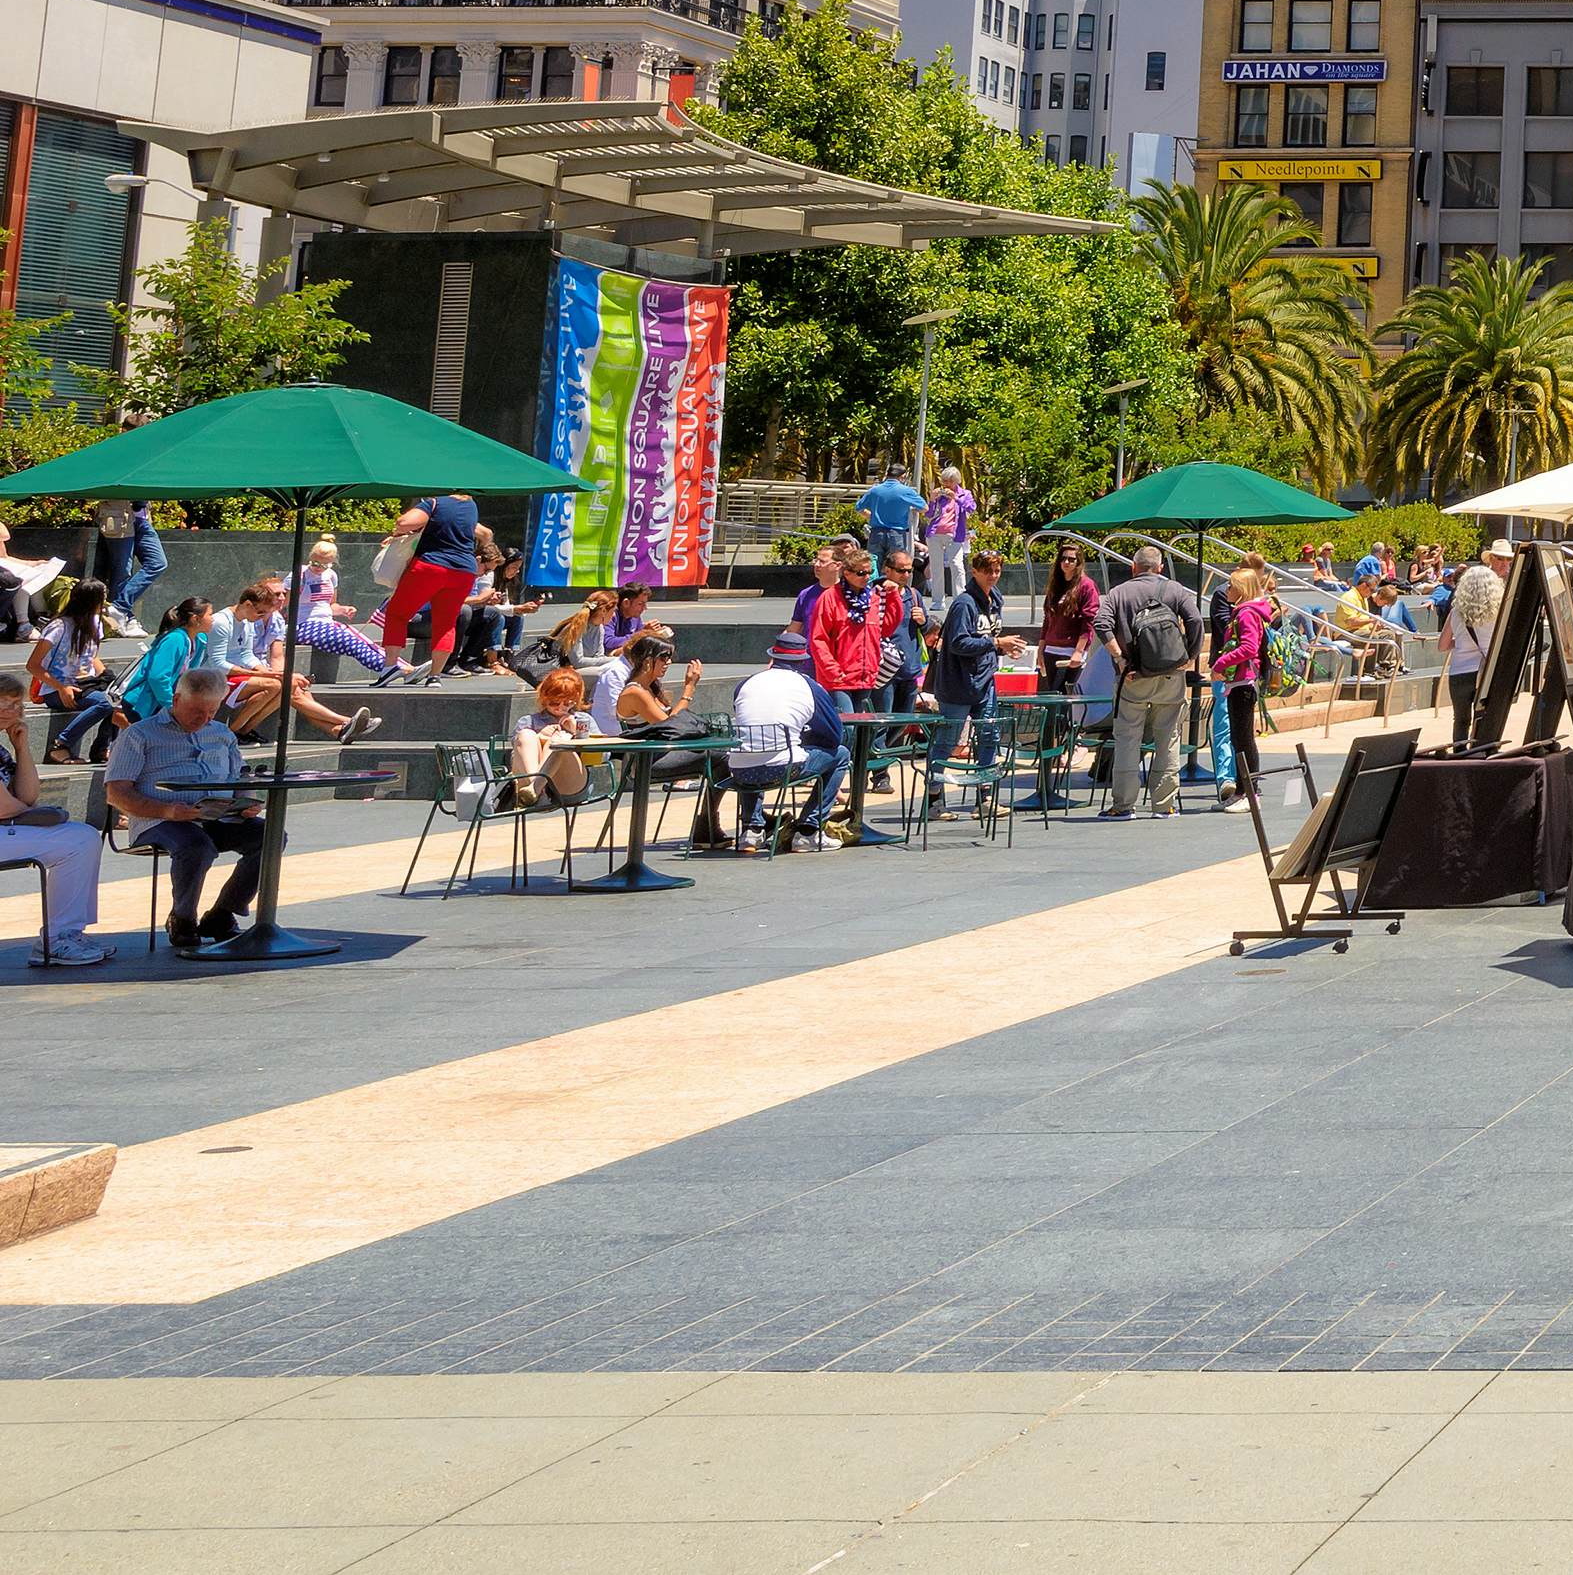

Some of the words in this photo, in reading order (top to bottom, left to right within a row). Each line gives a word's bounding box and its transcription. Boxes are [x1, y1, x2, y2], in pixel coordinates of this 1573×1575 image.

[1226, 63, 1301, 79] JAHAN
[1322, 63, 1380, 74] DIAMONDS
[647, 293, 664, 349] LIVE
[693, 300, 708, 353] LIVE
[633, 356, 664, 469] SQUARE
[679, 362, 700, 471] SQUARE
[539, 492, 559, 569] UNIO
[623, 478, 647, 572] UNION
[671, 479, 692, 571] UNION
